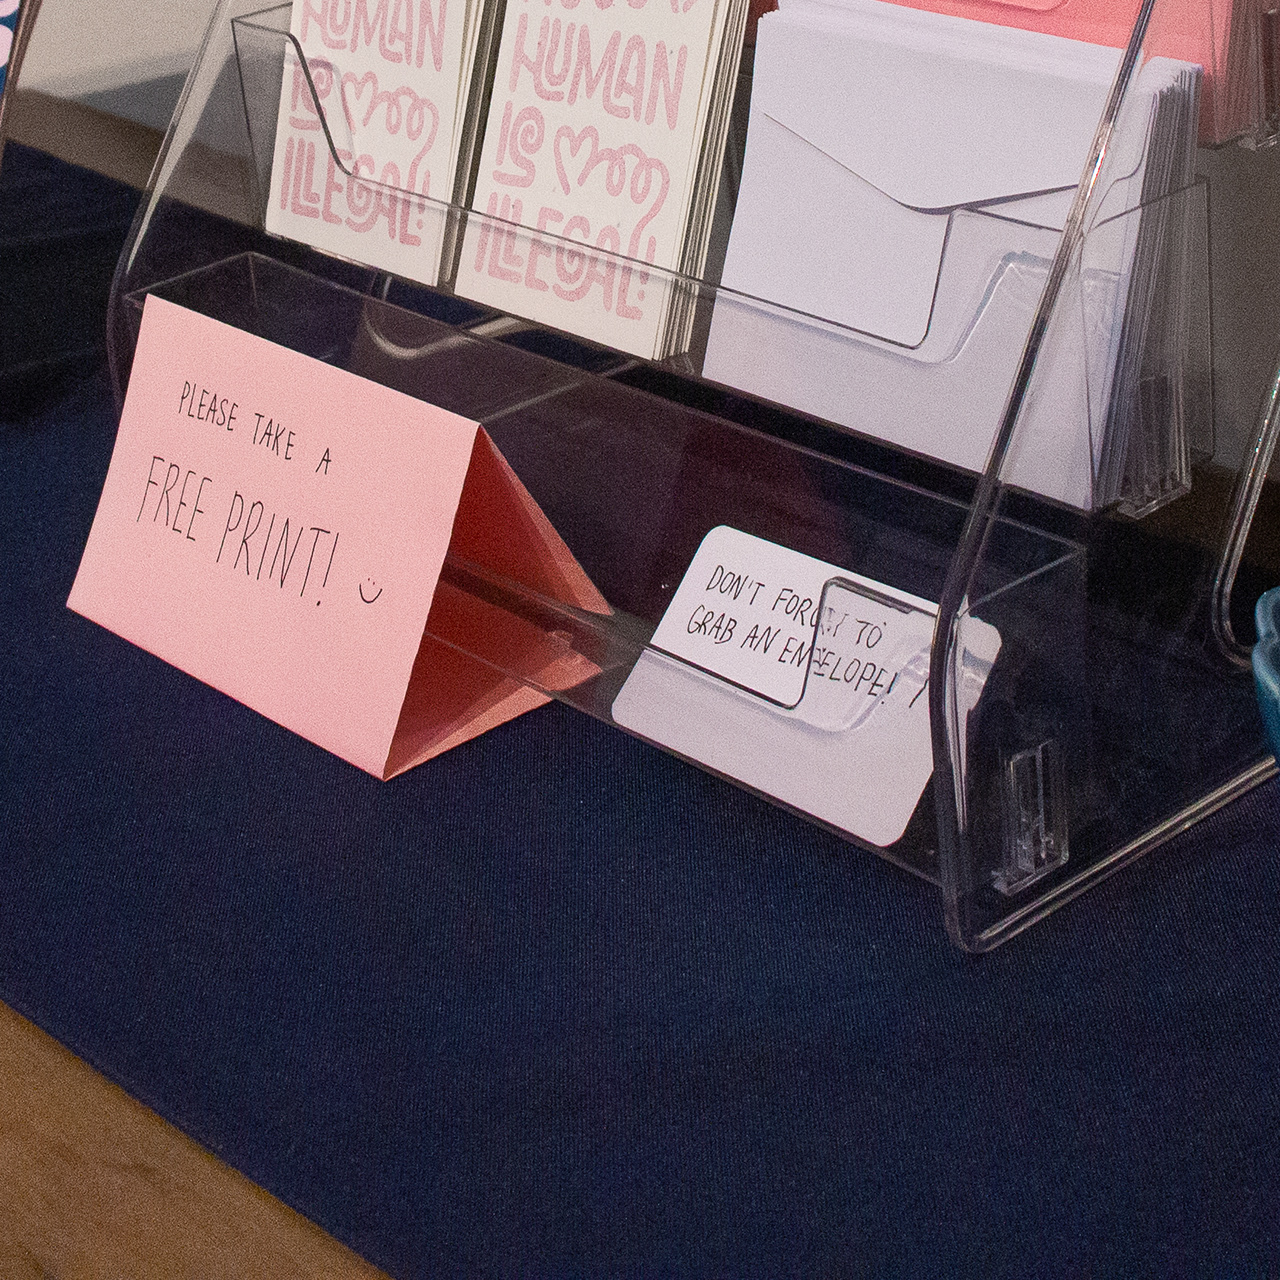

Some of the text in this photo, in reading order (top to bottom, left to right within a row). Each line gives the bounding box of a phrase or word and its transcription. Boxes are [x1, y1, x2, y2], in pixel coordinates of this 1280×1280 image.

[508, 12, 689, 131] HUMAN
[280, 136, 431, 248] ILLEGAL!
[492, 100, 545, 188] IS
[474, 191, 657, 321] ILLEGAL!
[177, 380, 332, 476] PLEASE TAKE A
[136, 455, 340, 607] FREE PRINT!
[686, 603, 738, 645] GRAB
[740, 623, 781, 655] AN
[705, 564, 884, 650] DON'T FORGT TO
